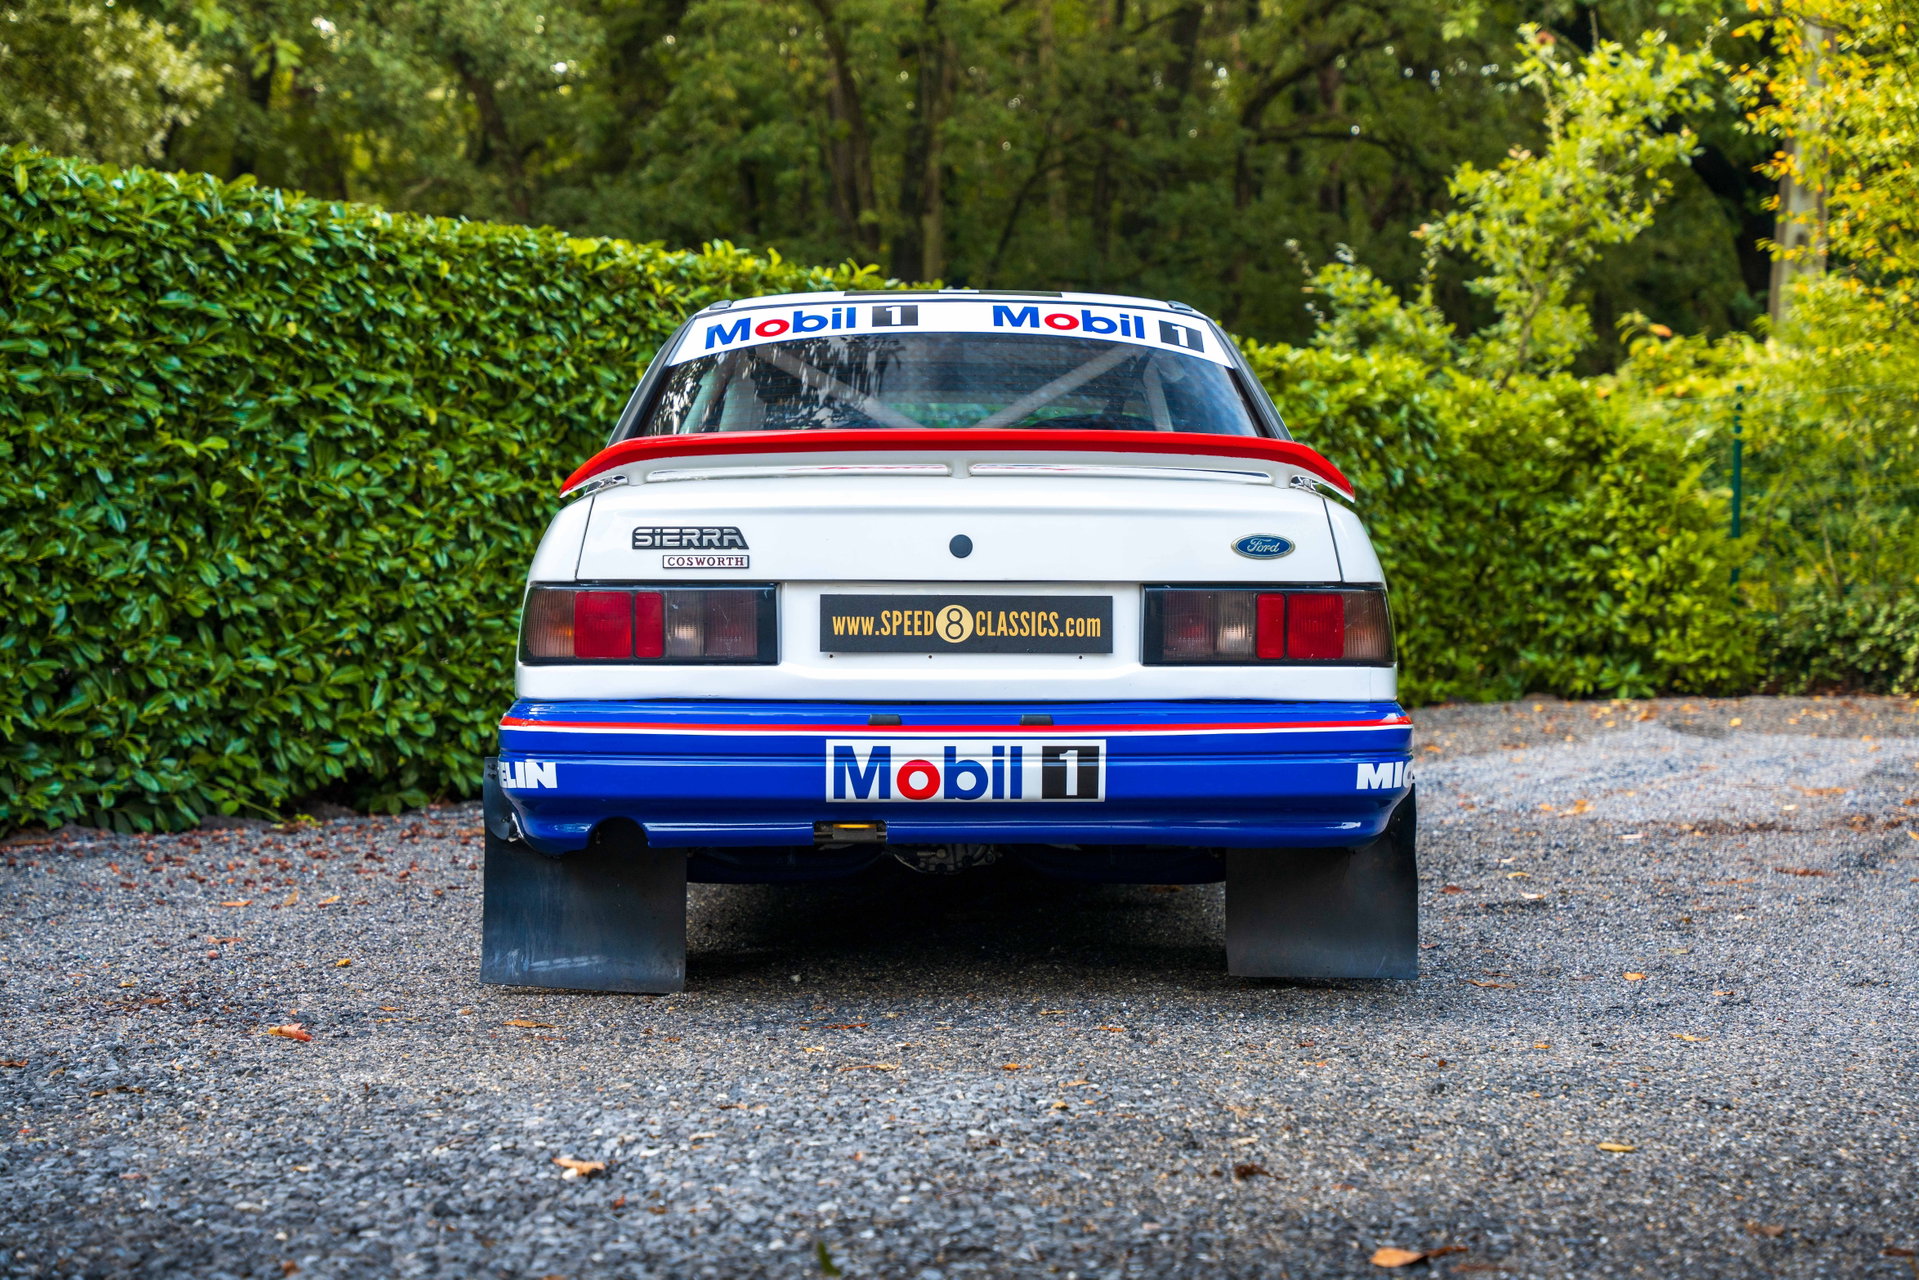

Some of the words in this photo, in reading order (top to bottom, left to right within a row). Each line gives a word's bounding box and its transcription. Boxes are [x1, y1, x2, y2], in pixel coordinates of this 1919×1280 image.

[705, 307, 856, 350] Mobil
[992, 305, 1145, 340] Mobil
[667, 556, 745, 566] COSWORTH
[1246, 538, 1281, 552] Ford
[833, 745, 1023, 800] Mobil
